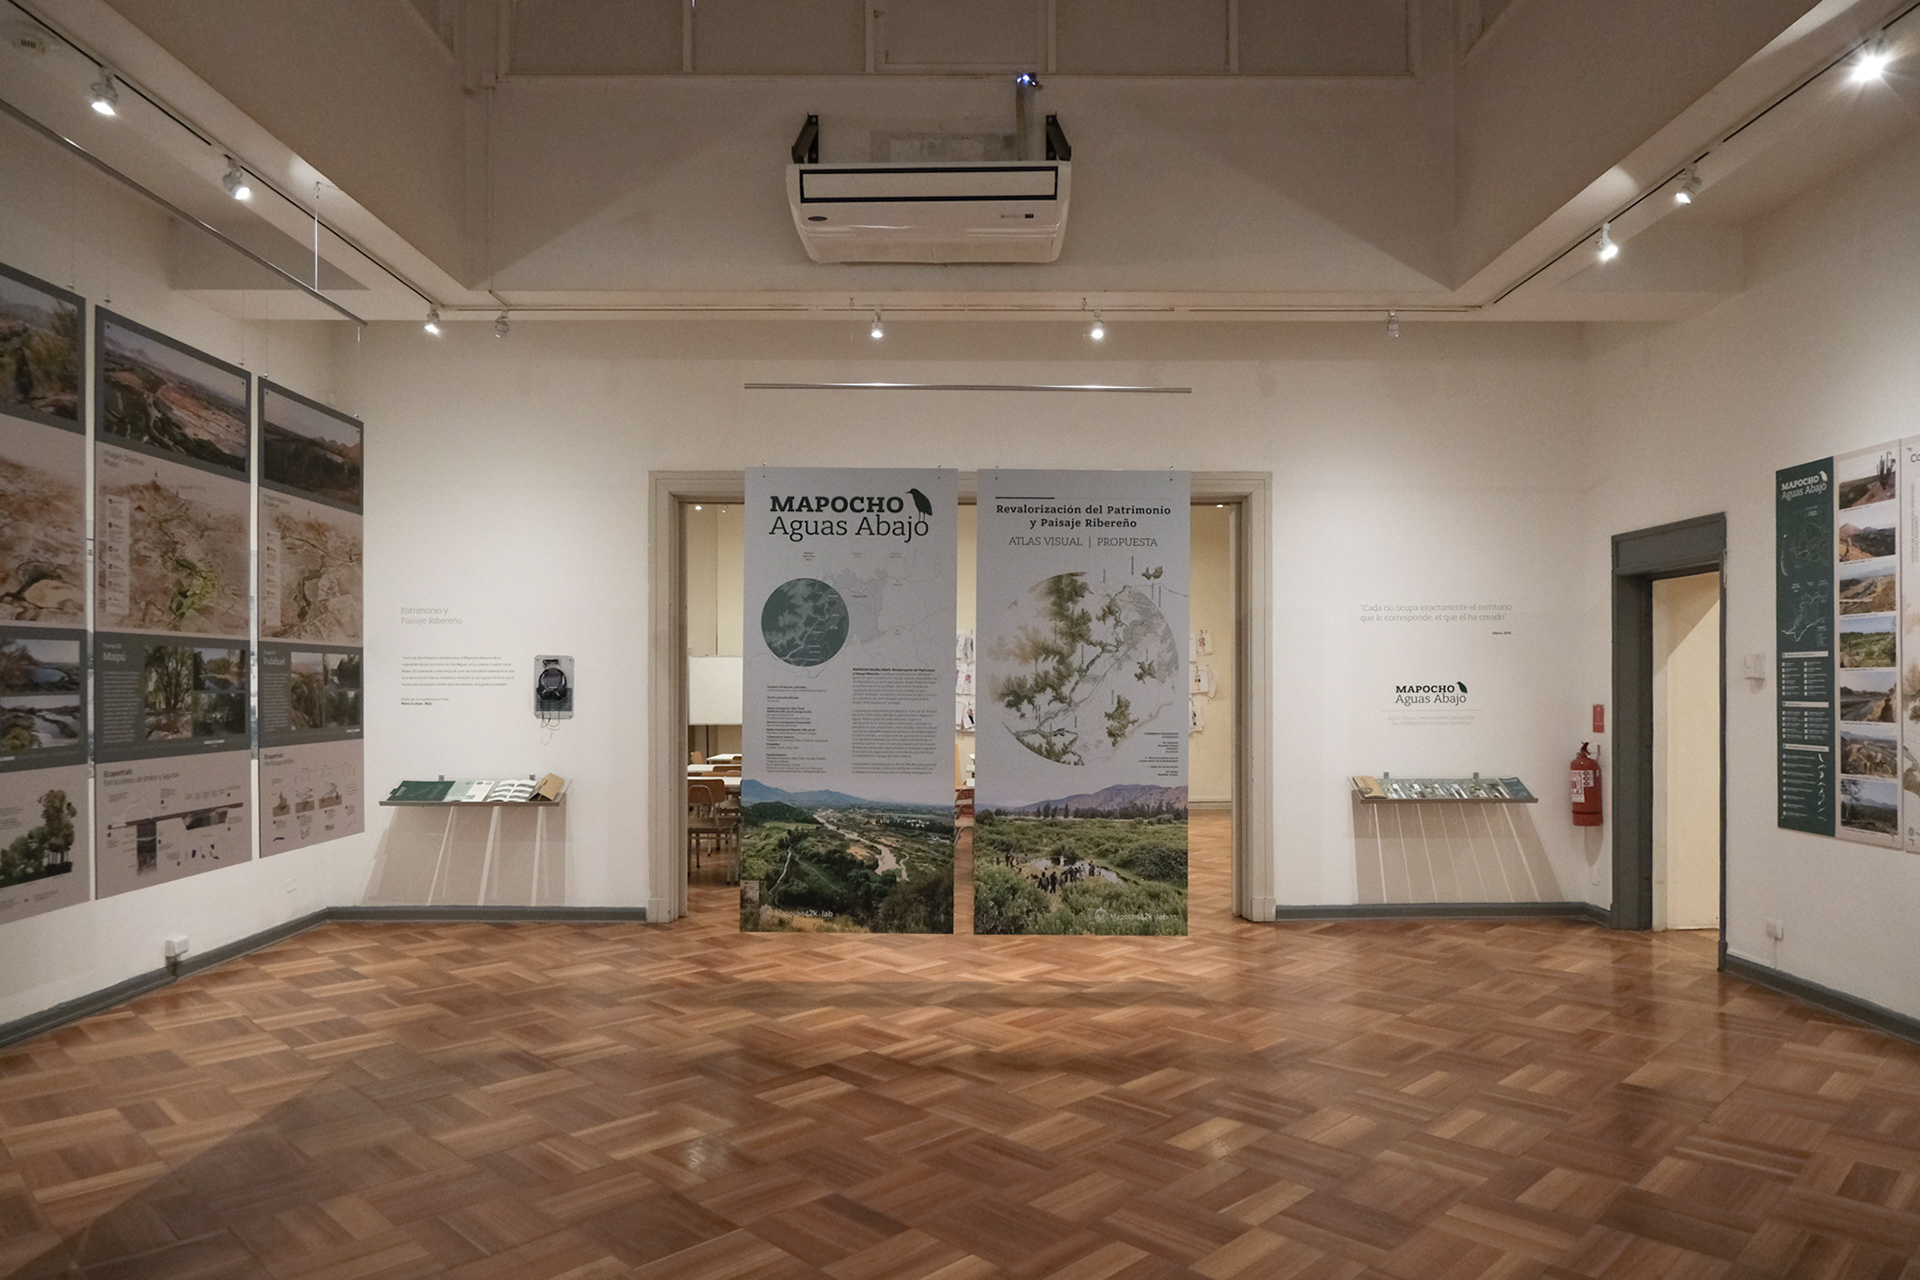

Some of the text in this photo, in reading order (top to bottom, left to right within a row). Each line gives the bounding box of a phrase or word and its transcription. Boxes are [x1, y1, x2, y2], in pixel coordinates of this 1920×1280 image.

[1781, 475, 1819, 491] MAPOCHO
[1781, 483, 1827, 501] Aguas Abajo
[770, 496, 904, 513] MAPOCHO
[996, 504, 1171, 515] Revalorización del Patrimonio
[769, 514, 929, 543] Aguas Abajo
[1030, 518, 1137, 529] y Paisaje Ribereño
[1008, 537, 1158, 546] ATLAS VISUAL PROPUESTA
[443, 608, 449, 616] y
[1396, 605, 1419, 614] ocupa
[1420, 604, 1468, 612] exactamente
[1470, 603, 1477, 611] el
[1360, 615, 1375, 623] que
[1376, 614, 1383, 622] le
[1443, 614, 1458, 623] que
[1468, 613, 1477, 621] ha
[1396, 685, 1455, 693] MAPOCHO
[1395, 693, 1467, 706] Aguas Abajo
